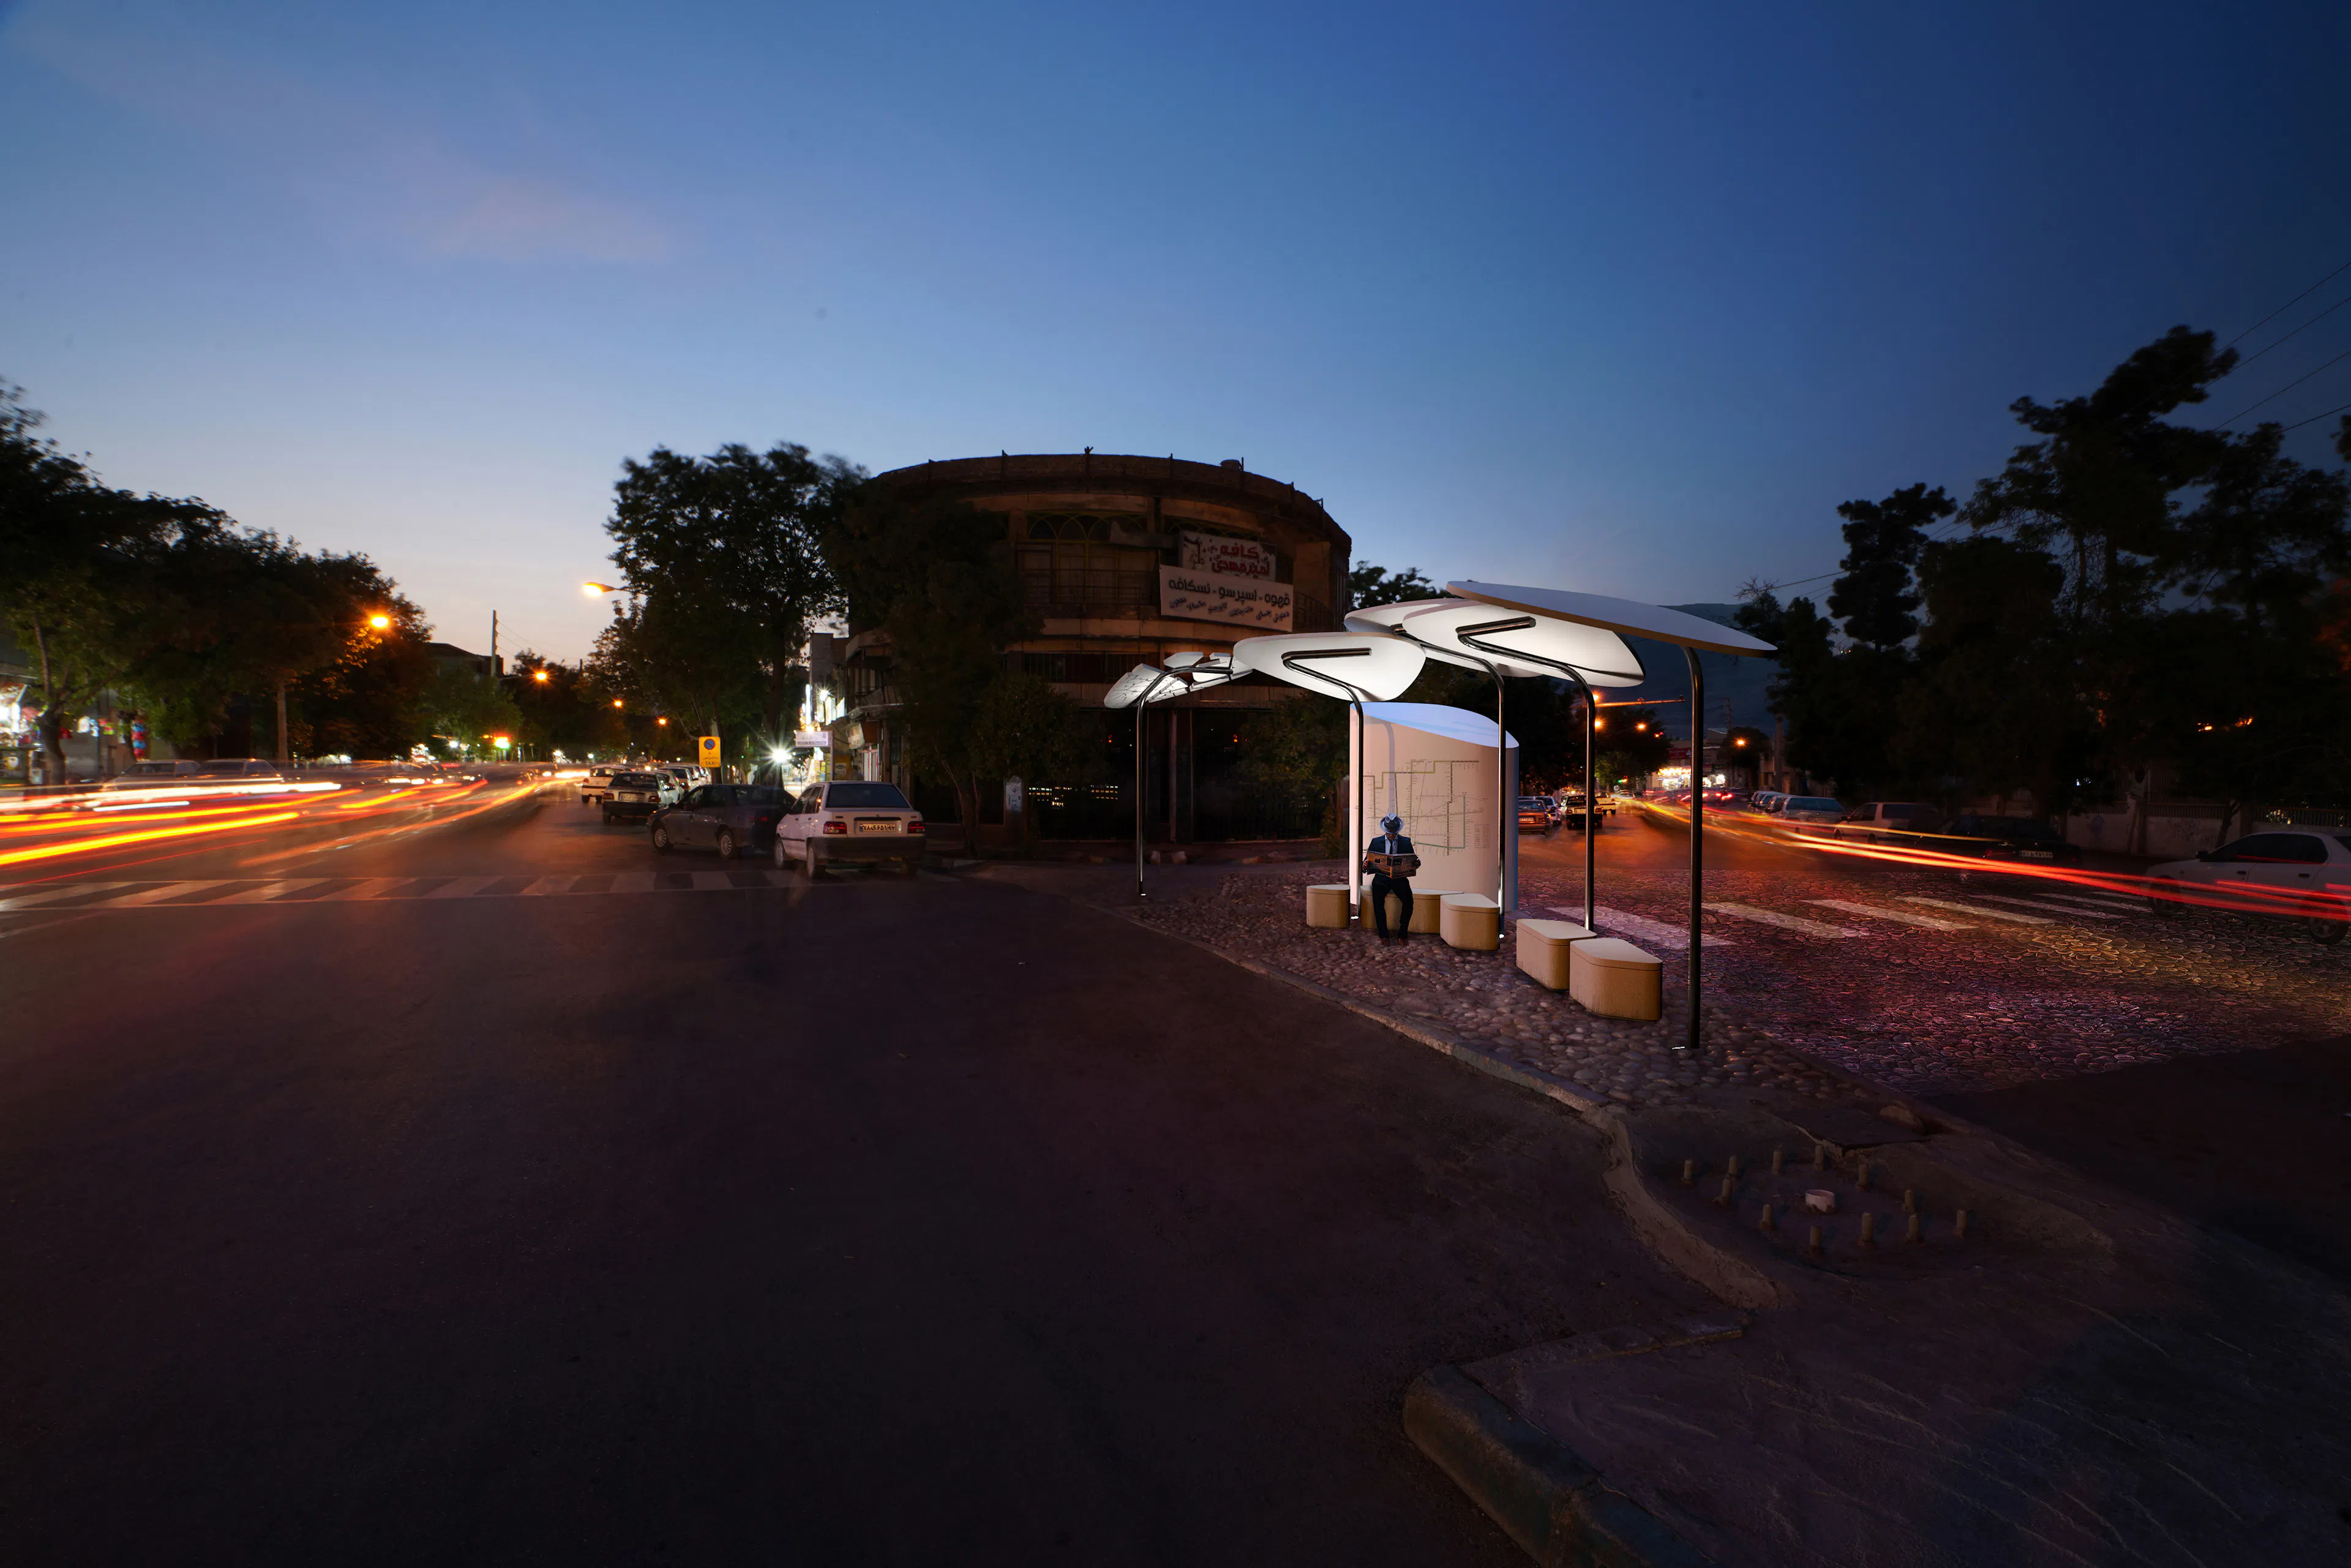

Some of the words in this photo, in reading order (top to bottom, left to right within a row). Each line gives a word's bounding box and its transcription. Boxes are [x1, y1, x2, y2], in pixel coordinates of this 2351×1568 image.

[1220, 542, 1259, 560] کافه
[1168, 577, 1211, 594] نسکافه
[1218, 586, 1258, 604] اسپرسو
[1264, 592, 1290, 608] قهوه
